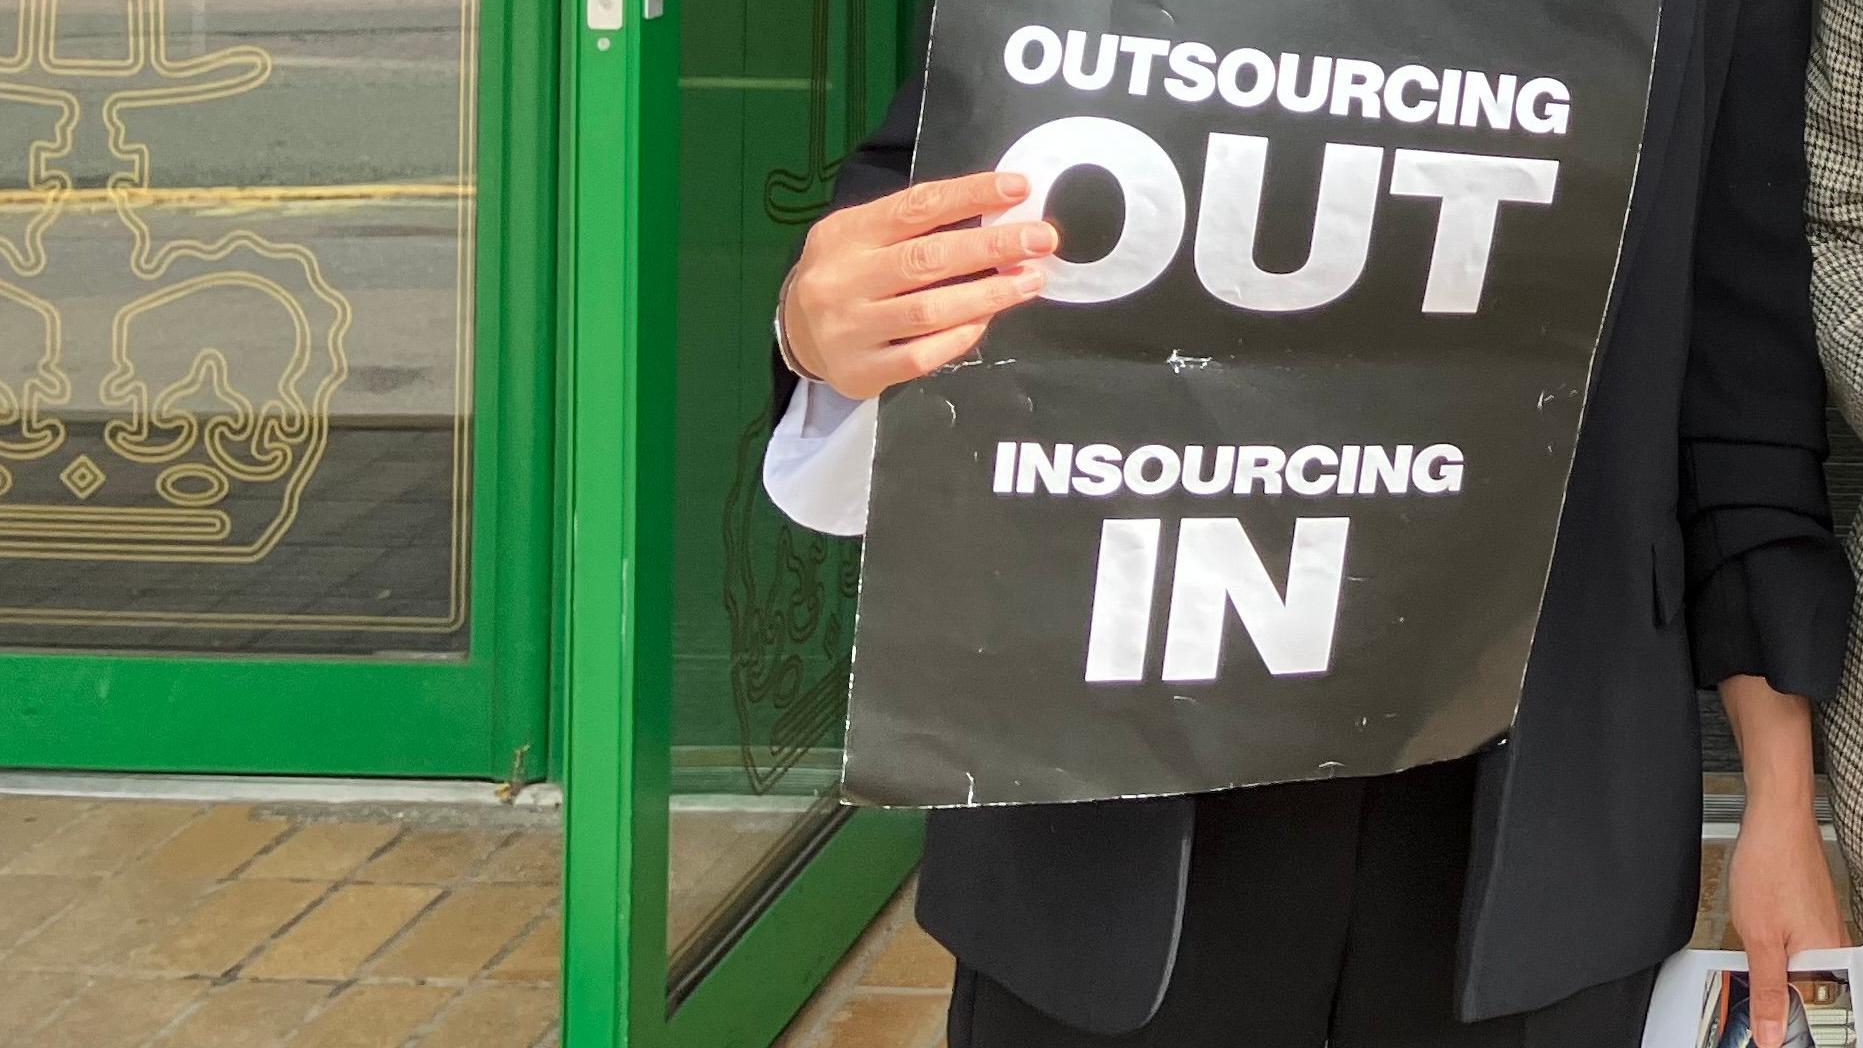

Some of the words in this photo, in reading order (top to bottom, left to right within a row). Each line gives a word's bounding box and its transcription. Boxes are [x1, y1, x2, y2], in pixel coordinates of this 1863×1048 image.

[1003, 25, 1571, 135] OUTSOURCING
[983, 116, 1560, 314] OUT
[992, 441, 1464, 496] INSOURCING
[1084, 516, 1350, 683] IN
